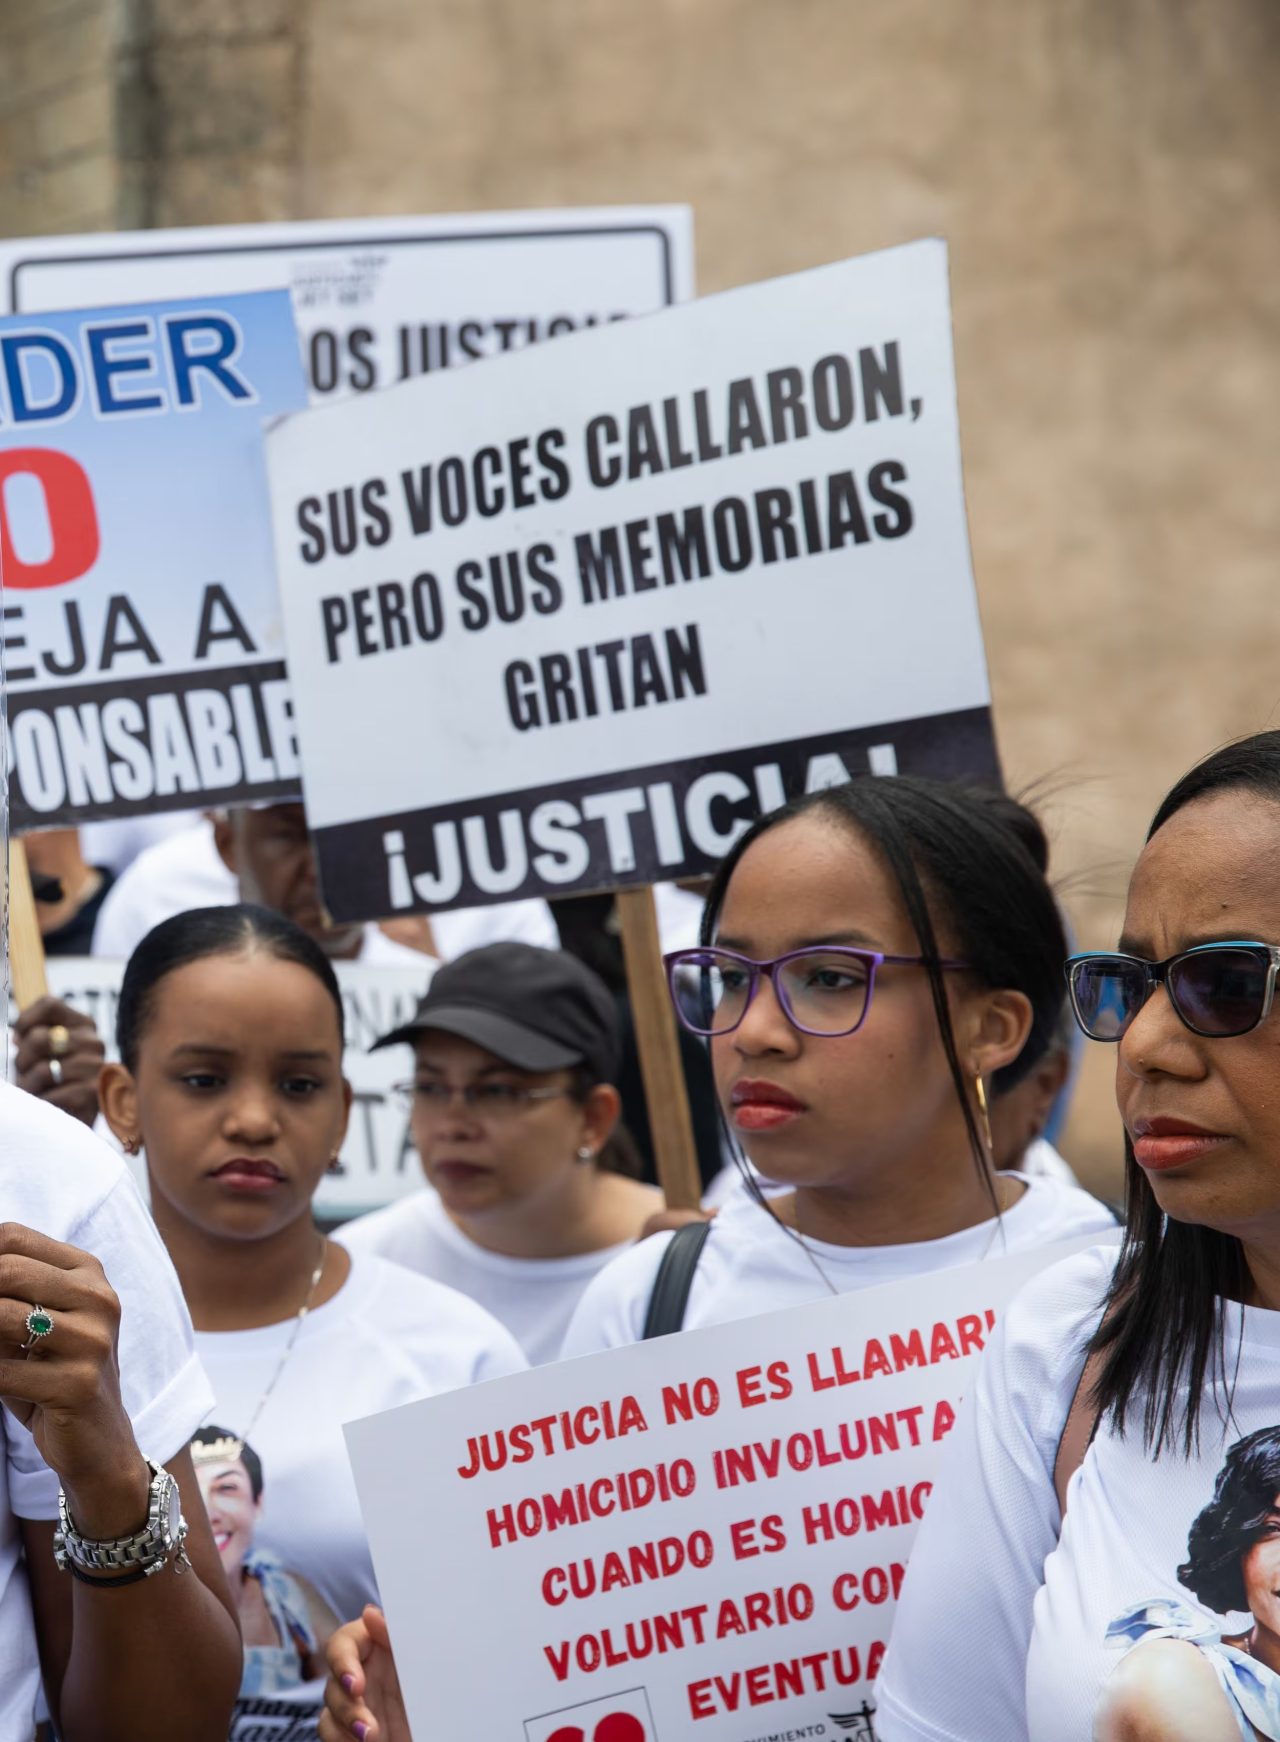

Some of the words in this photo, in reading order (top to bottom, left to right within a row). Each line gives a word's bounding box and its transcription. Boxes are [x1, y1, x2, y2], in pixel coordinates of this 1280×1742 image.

[297, 477, 392, 564] SUS
[401, 427, 570, 537] VOCES
[585, 340, 922, 488] CALLARON,
[194, 582, 258, 660] A
[321, 570, 444, 664] PERO
[455, 542, 563, 632] SUS
[574, 459, 914, 605] MEMORIAS
[504, 622, 708, 732] GRITAN
[8, 678, 300, 813] ONSABLE
[457, 1395, 648, 1479] JUSTICIA
[661, 1377, 720, 1425] NO
[736, 1360, 792, 1408] ES
[486, 1459, 696, 1548] HOMICIDIO
[713, 1396, 960, 1489] INVOLUNTA
[542, 1530, 713, 1607] CUANDO
[730, 1514, 786, 1561] ES
[544, 1582, 814, 1682] VOLUNTARIO
